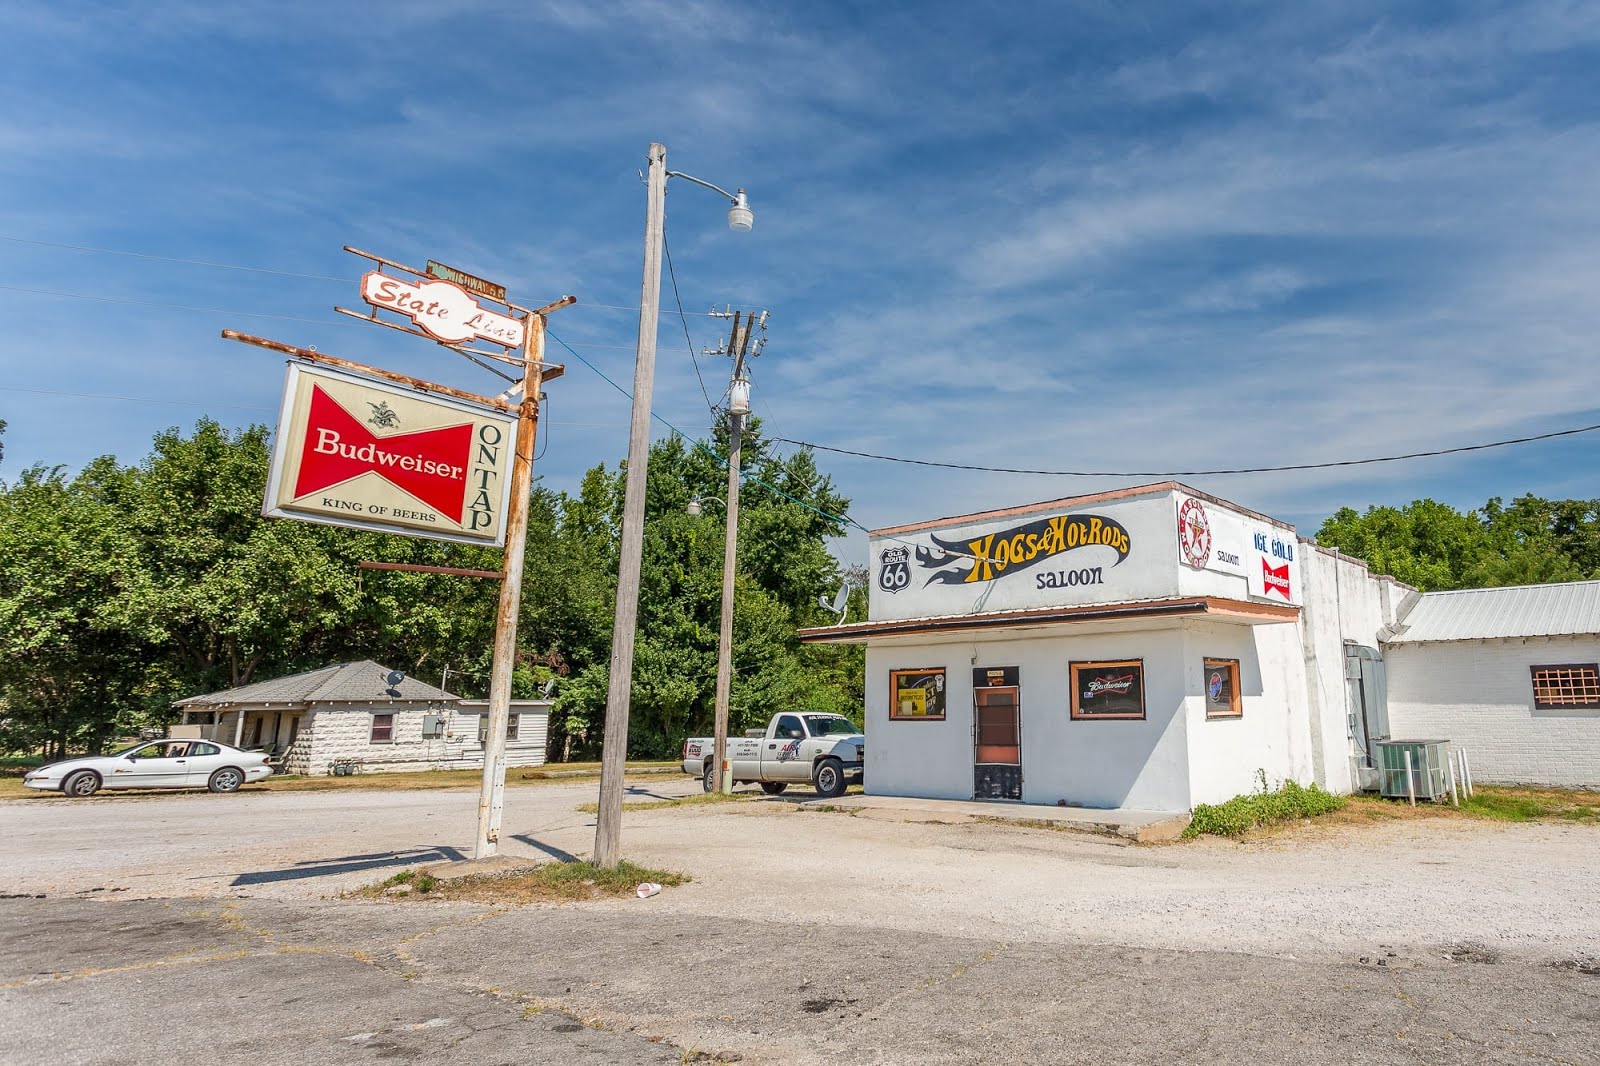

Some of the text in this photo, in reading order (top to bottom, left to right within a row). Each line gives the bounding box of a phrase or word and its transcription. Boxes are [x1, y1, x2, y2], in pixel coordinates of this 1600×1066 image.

[375, 281, 517, 341] State Line
[313, 427, 463, 480] Budweiser
[322, 498, 437, 523] KING OF BEERS
[885, 555, 907, 563] ROUTE
[1254, 533, 1293, 562] ICE COLD
[883, 563, 907, 588] 66
[1264, 570, 1290, 588] Budweiser
[1088, 680, 1132, 692] Budweiser
